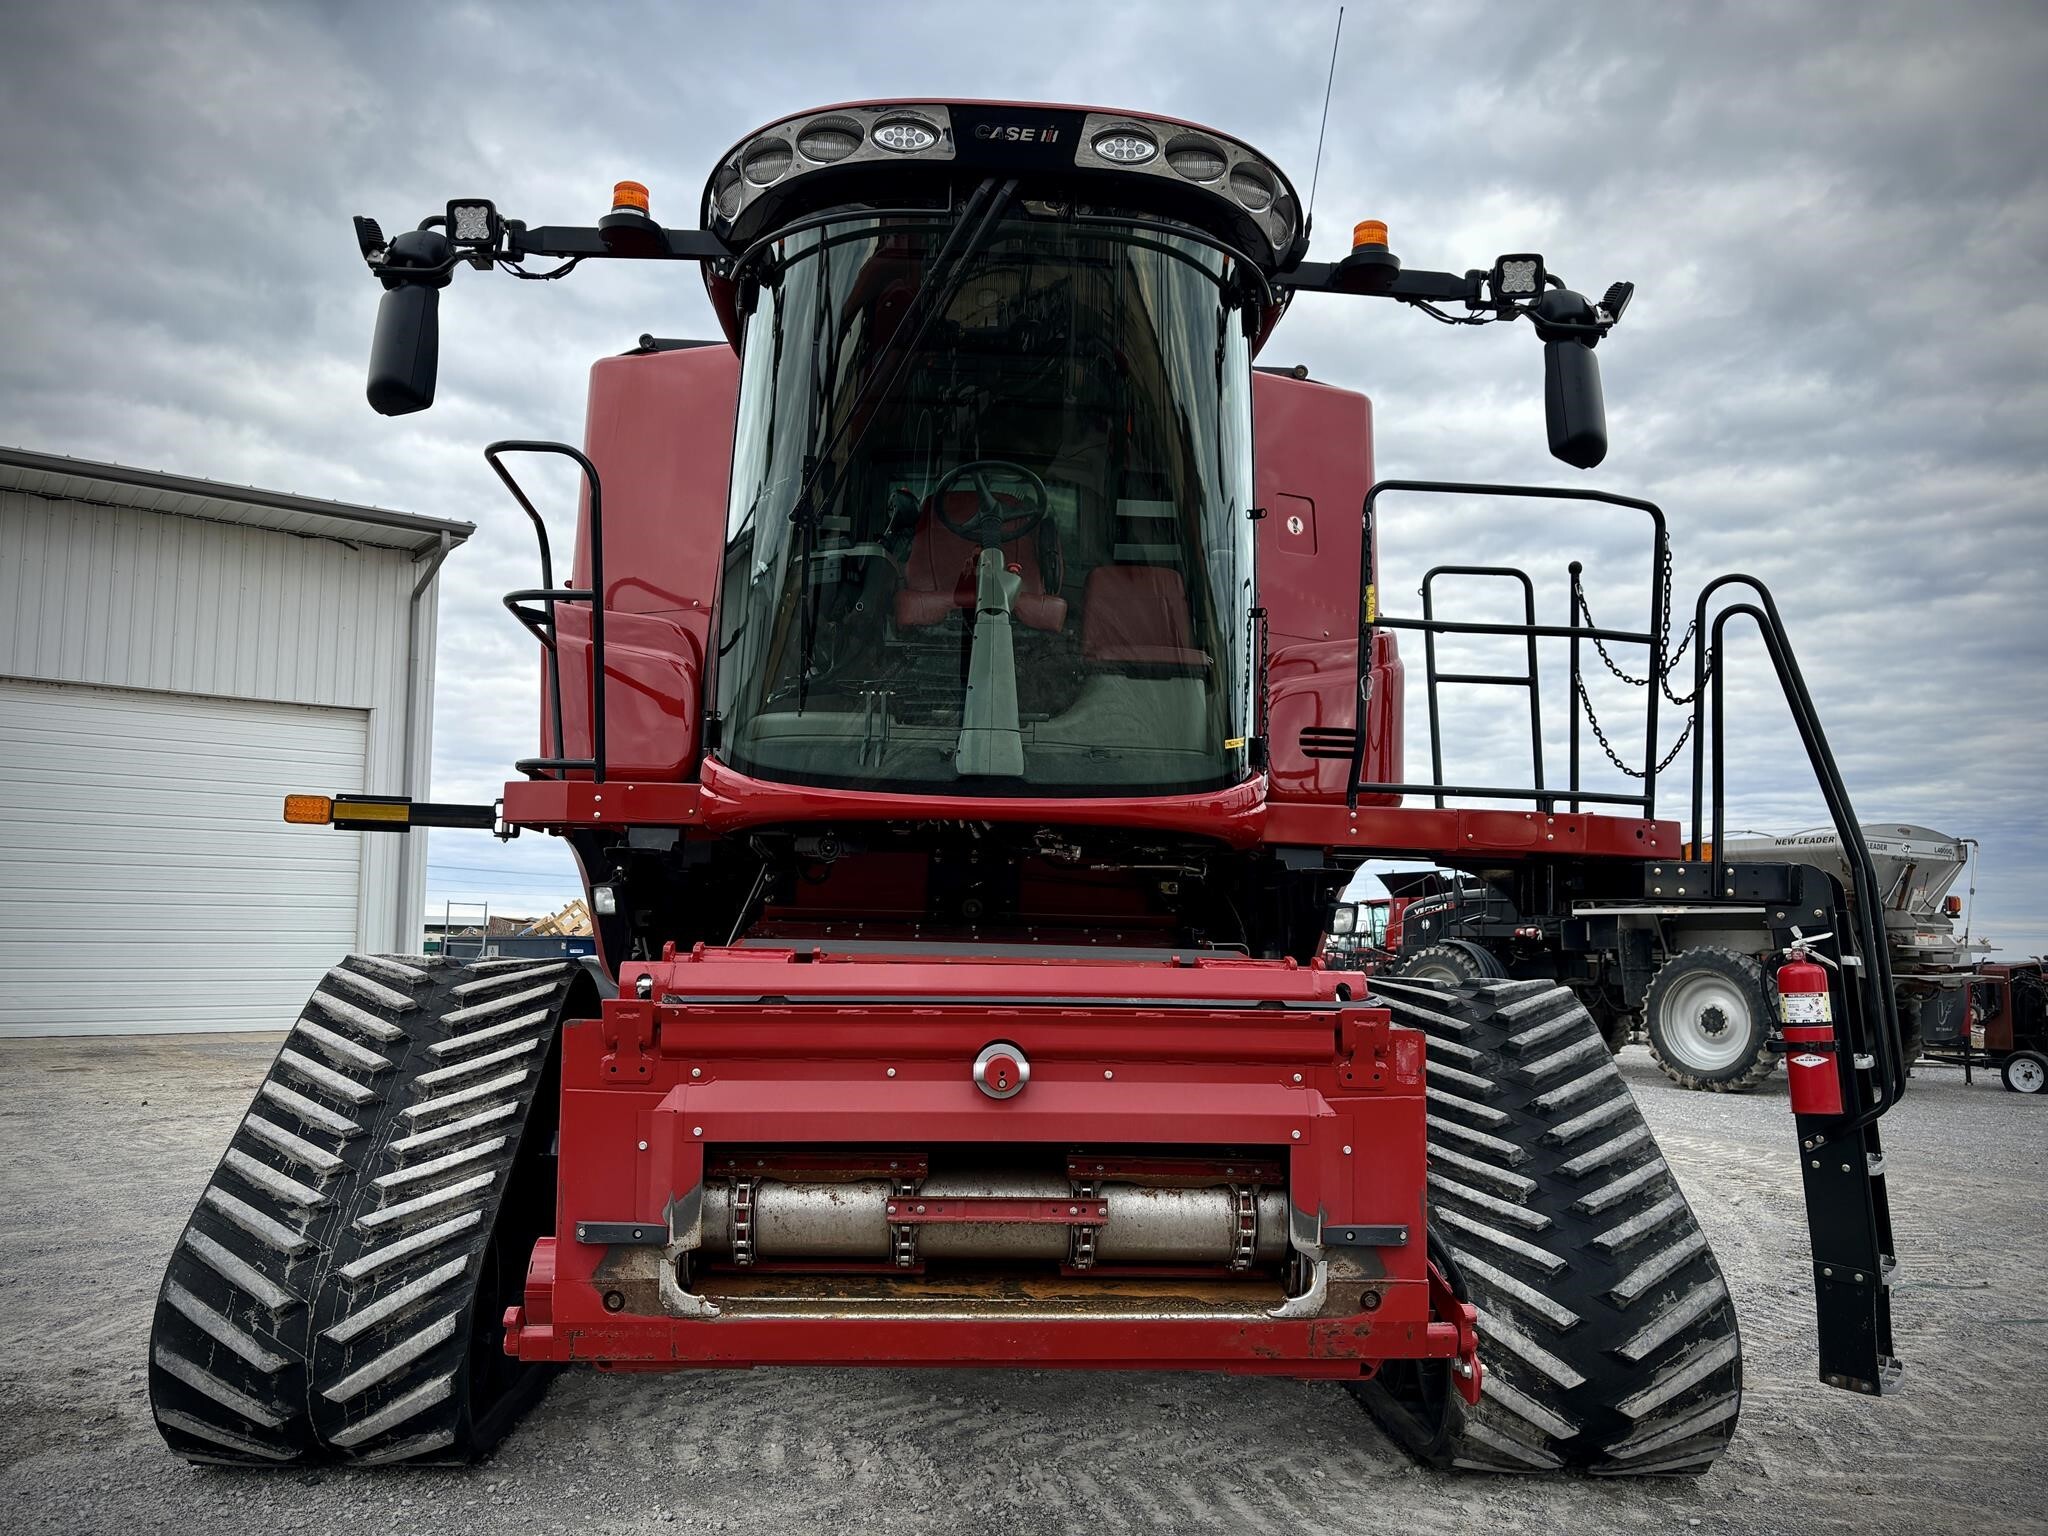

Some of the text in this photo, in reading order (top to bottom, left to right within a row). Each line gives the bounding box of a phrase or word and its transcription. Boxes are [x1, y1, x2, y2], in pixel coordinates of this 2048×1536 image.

[975, 124, 1035, 141] CASE
[1775, 836, 1835, 846] NEW LEADER
